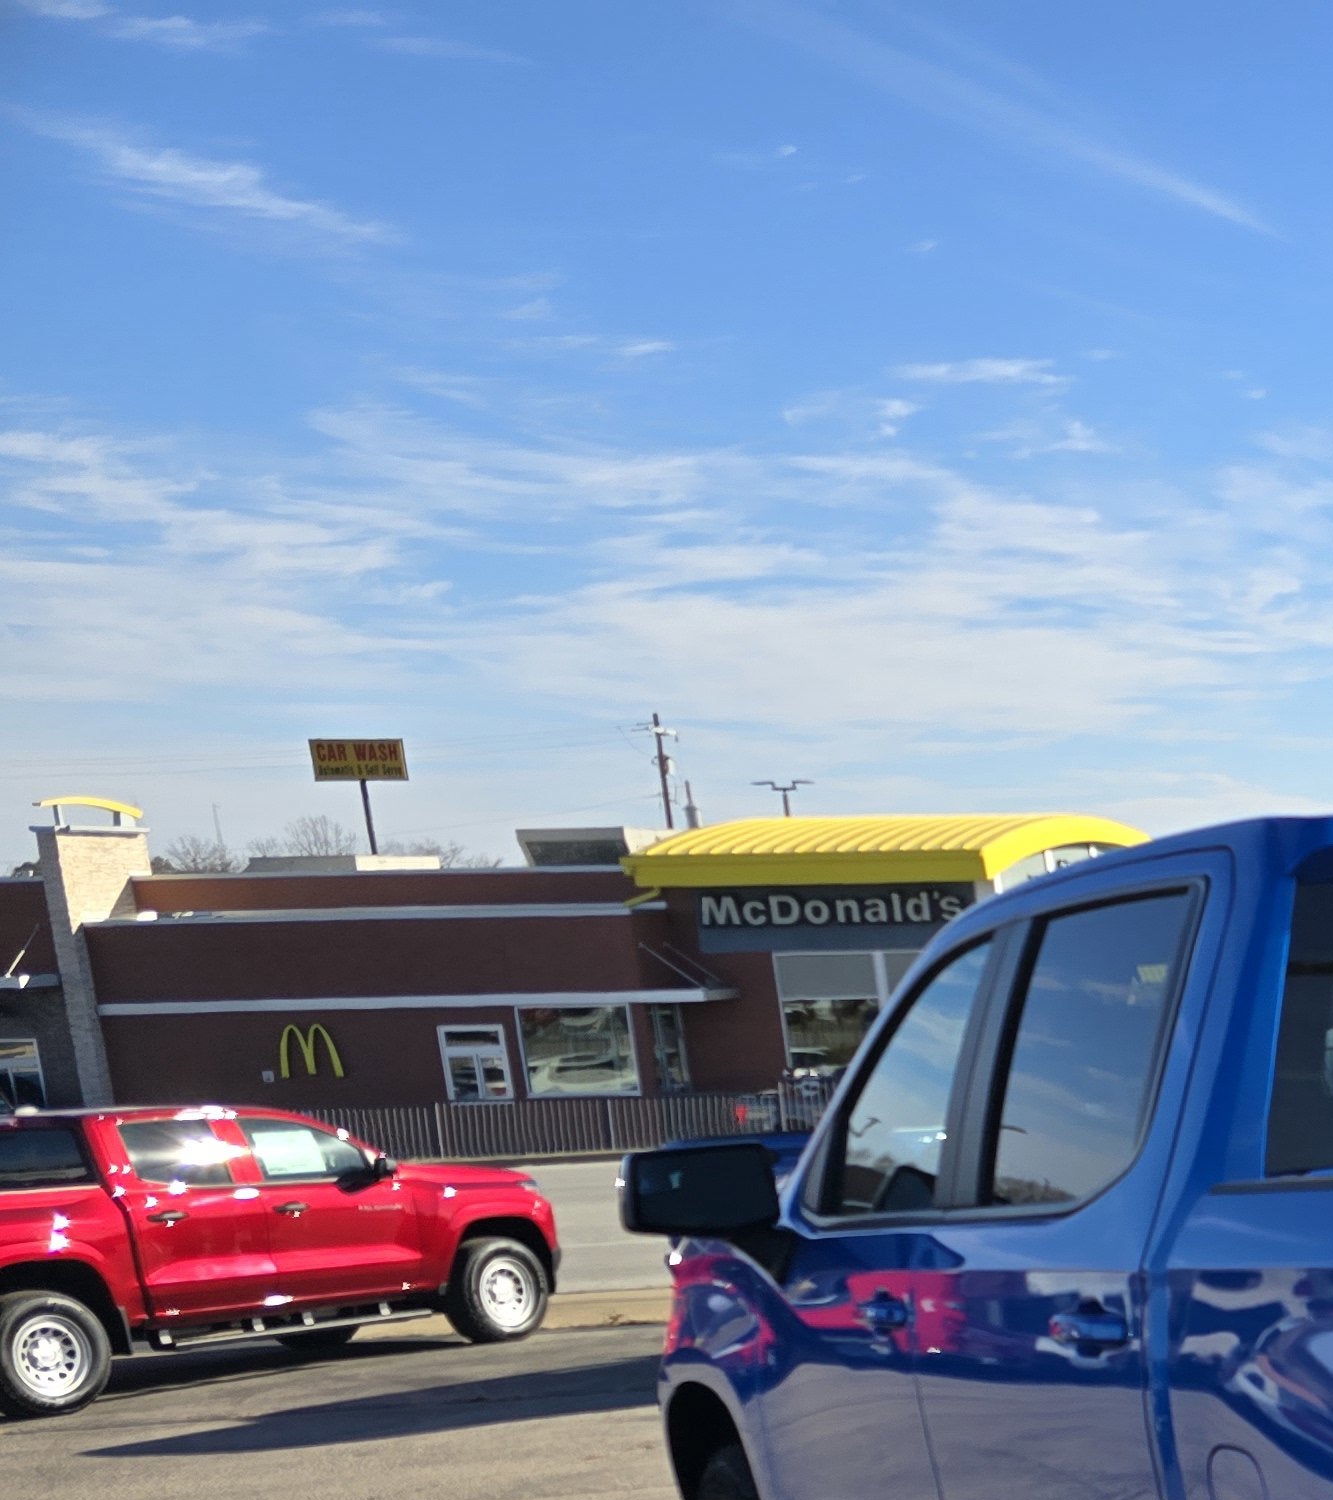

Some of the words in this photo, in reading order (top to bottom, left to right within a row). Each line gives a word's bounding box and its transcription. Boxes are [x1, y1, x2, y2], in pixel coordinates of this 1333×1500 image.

[315, 743, 347, 762] CAR
[353, 742, 399, 762] WASH
[701, 890, 964, 926] McDonald's
